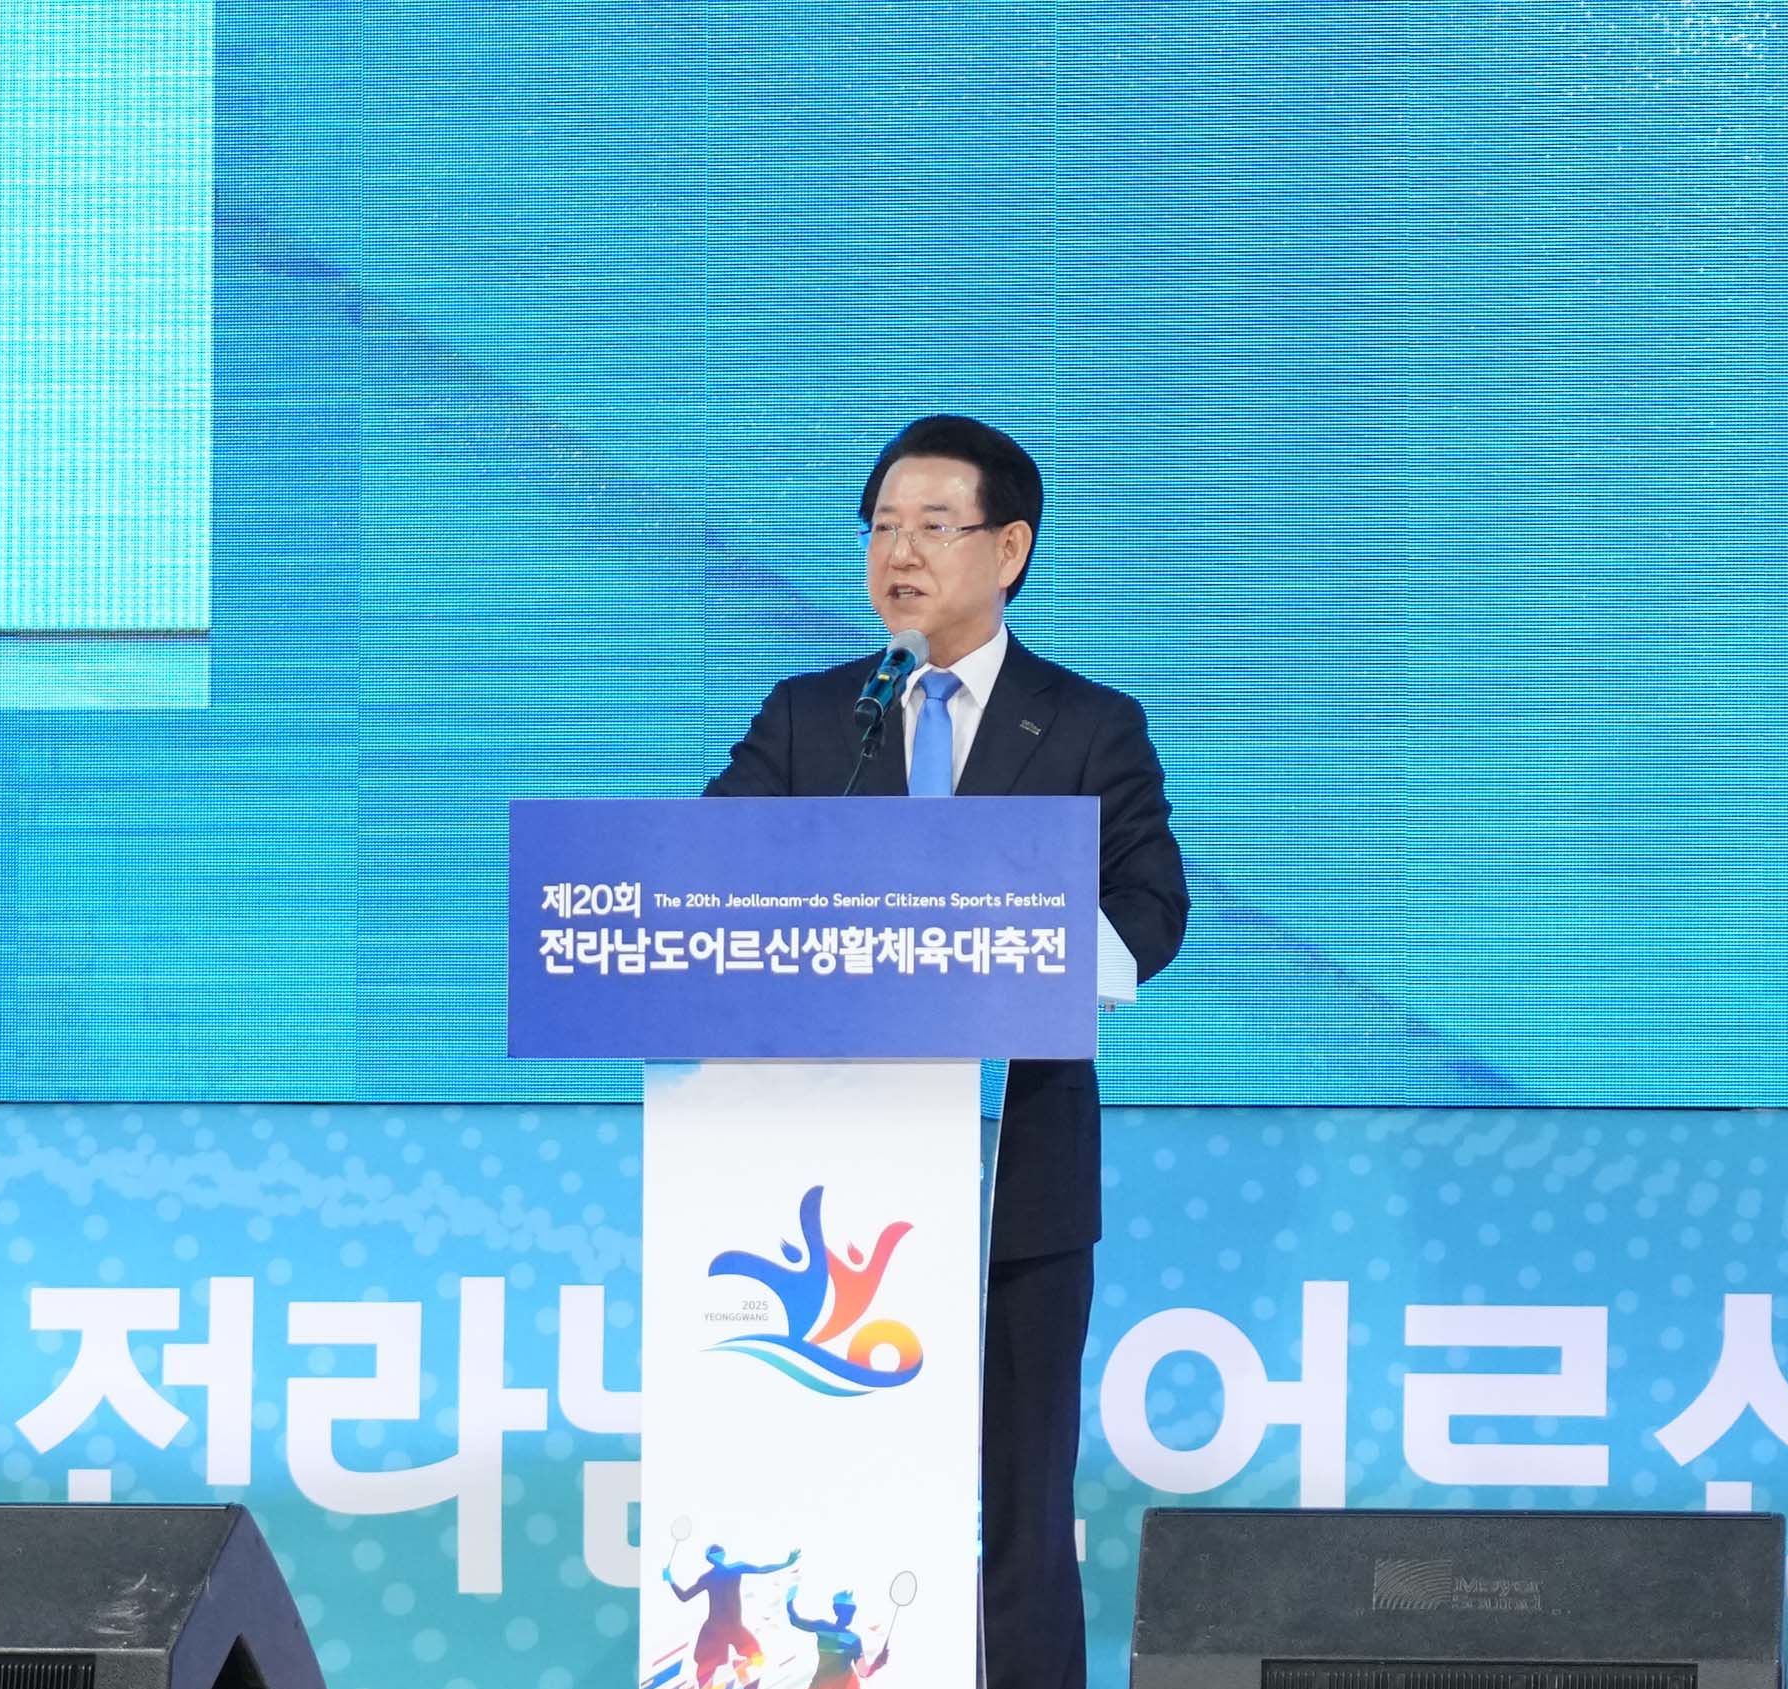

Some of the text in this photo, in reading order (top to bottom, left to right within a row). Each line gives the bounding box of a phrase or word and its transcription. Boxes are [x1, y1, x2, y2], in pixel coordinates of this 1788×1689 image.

[541, 882, 1066, 918] 제20회 The 20th Jeollanam-do Senior Citizens Sports Festival
[539, 926, 1066, 975] 전라남도어르신생활체육대축전
[704, 1312, 769, 1322] YEONGGWANG
[742, 1300, 769, 1311] 2025
